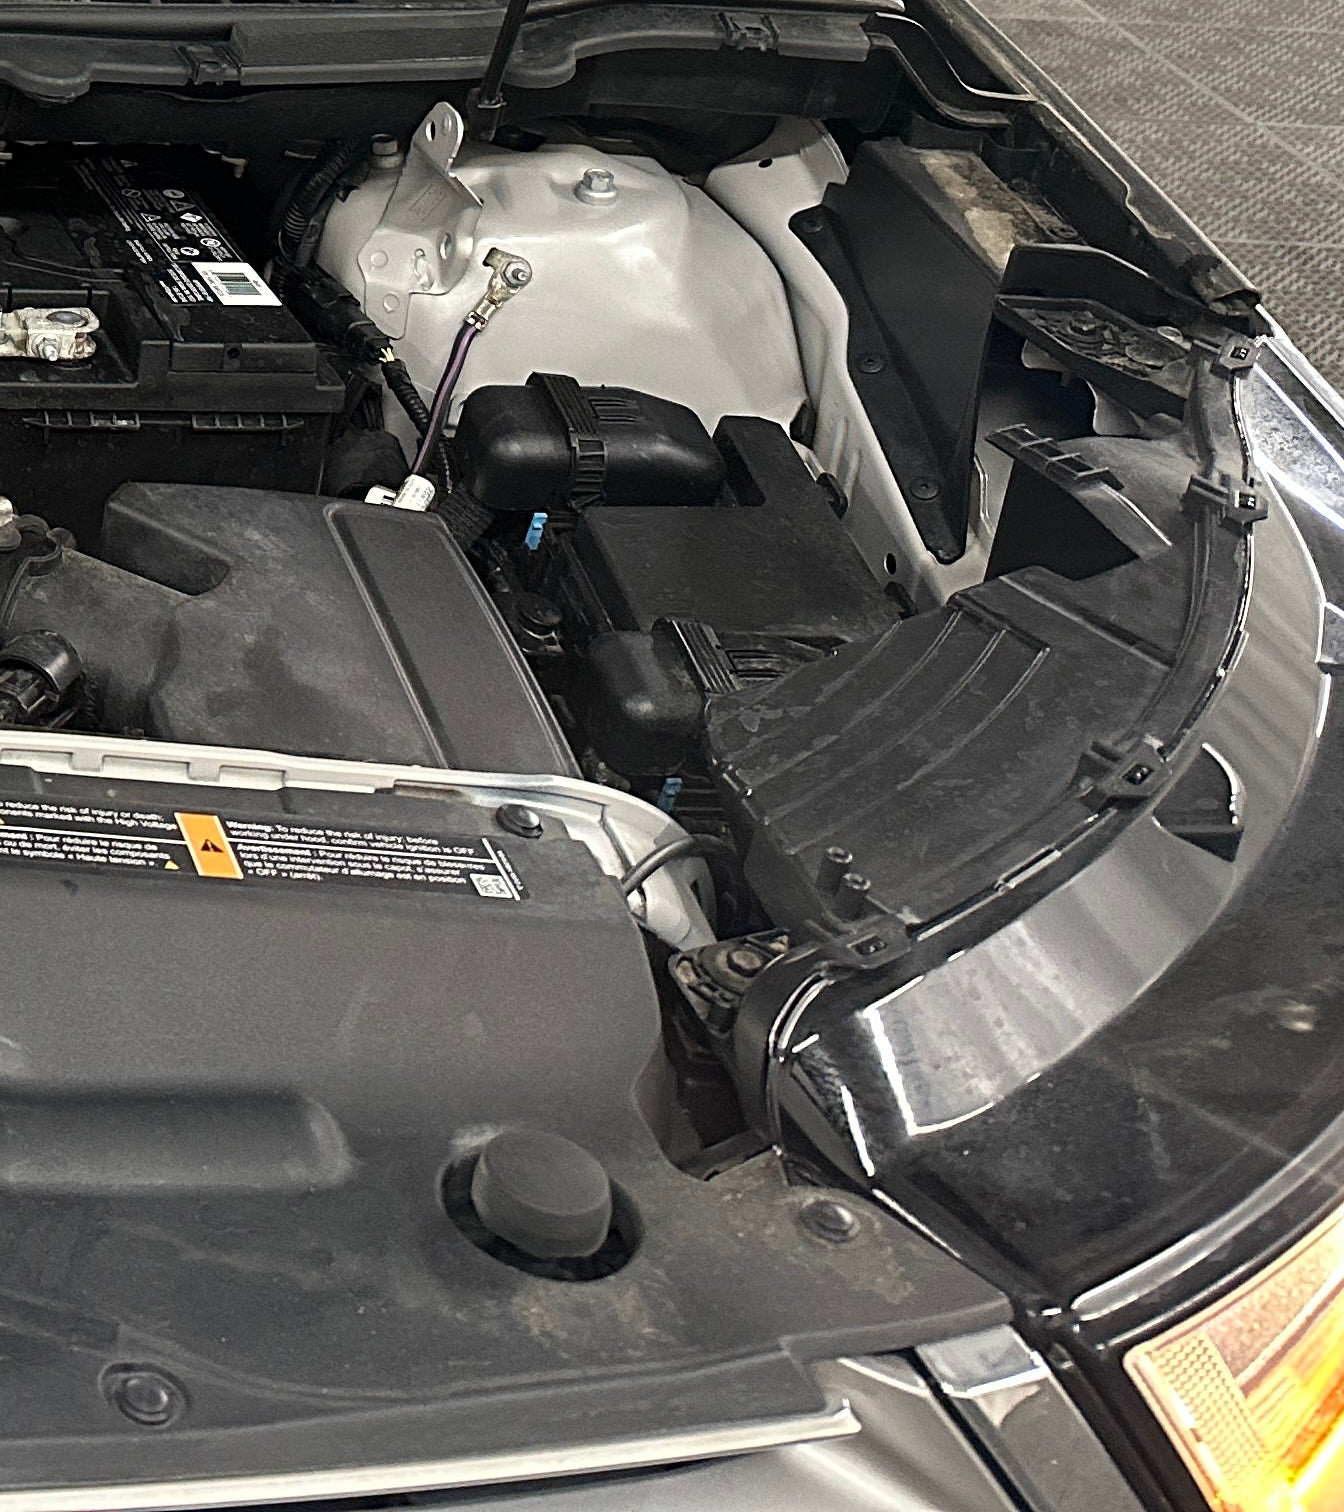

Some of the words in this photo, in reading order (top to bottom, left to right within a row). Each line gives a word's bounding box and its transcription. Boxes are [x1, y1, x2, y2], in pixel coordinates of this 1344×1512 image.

[35, 811, 72, 820] marked
[141, 821, 177, 830] Voltage
[92, 809, 117, 818] injury
[231, 830, 268, 840] working
[271, 833, 298, 842] under
[331, 839, 368, 848] confirm
[371, 841, 403, 850] vehicle
[406, 844, 440, 854] ignition
[290, 827, 322, 838] reduce
[406, 837, 438, 846] before
[23, 849, 65, 859] symbole
[77, 854, 107, 862] Haute
[109, 856, 145, 865] tension
[110, 849, 170, 858] composants
[237, 845, 312, 857] Avertissement
[439, 859, 485, 870] blessures
[290, 855, 346, 866] intervention
[428, 876, 466, 884] position
